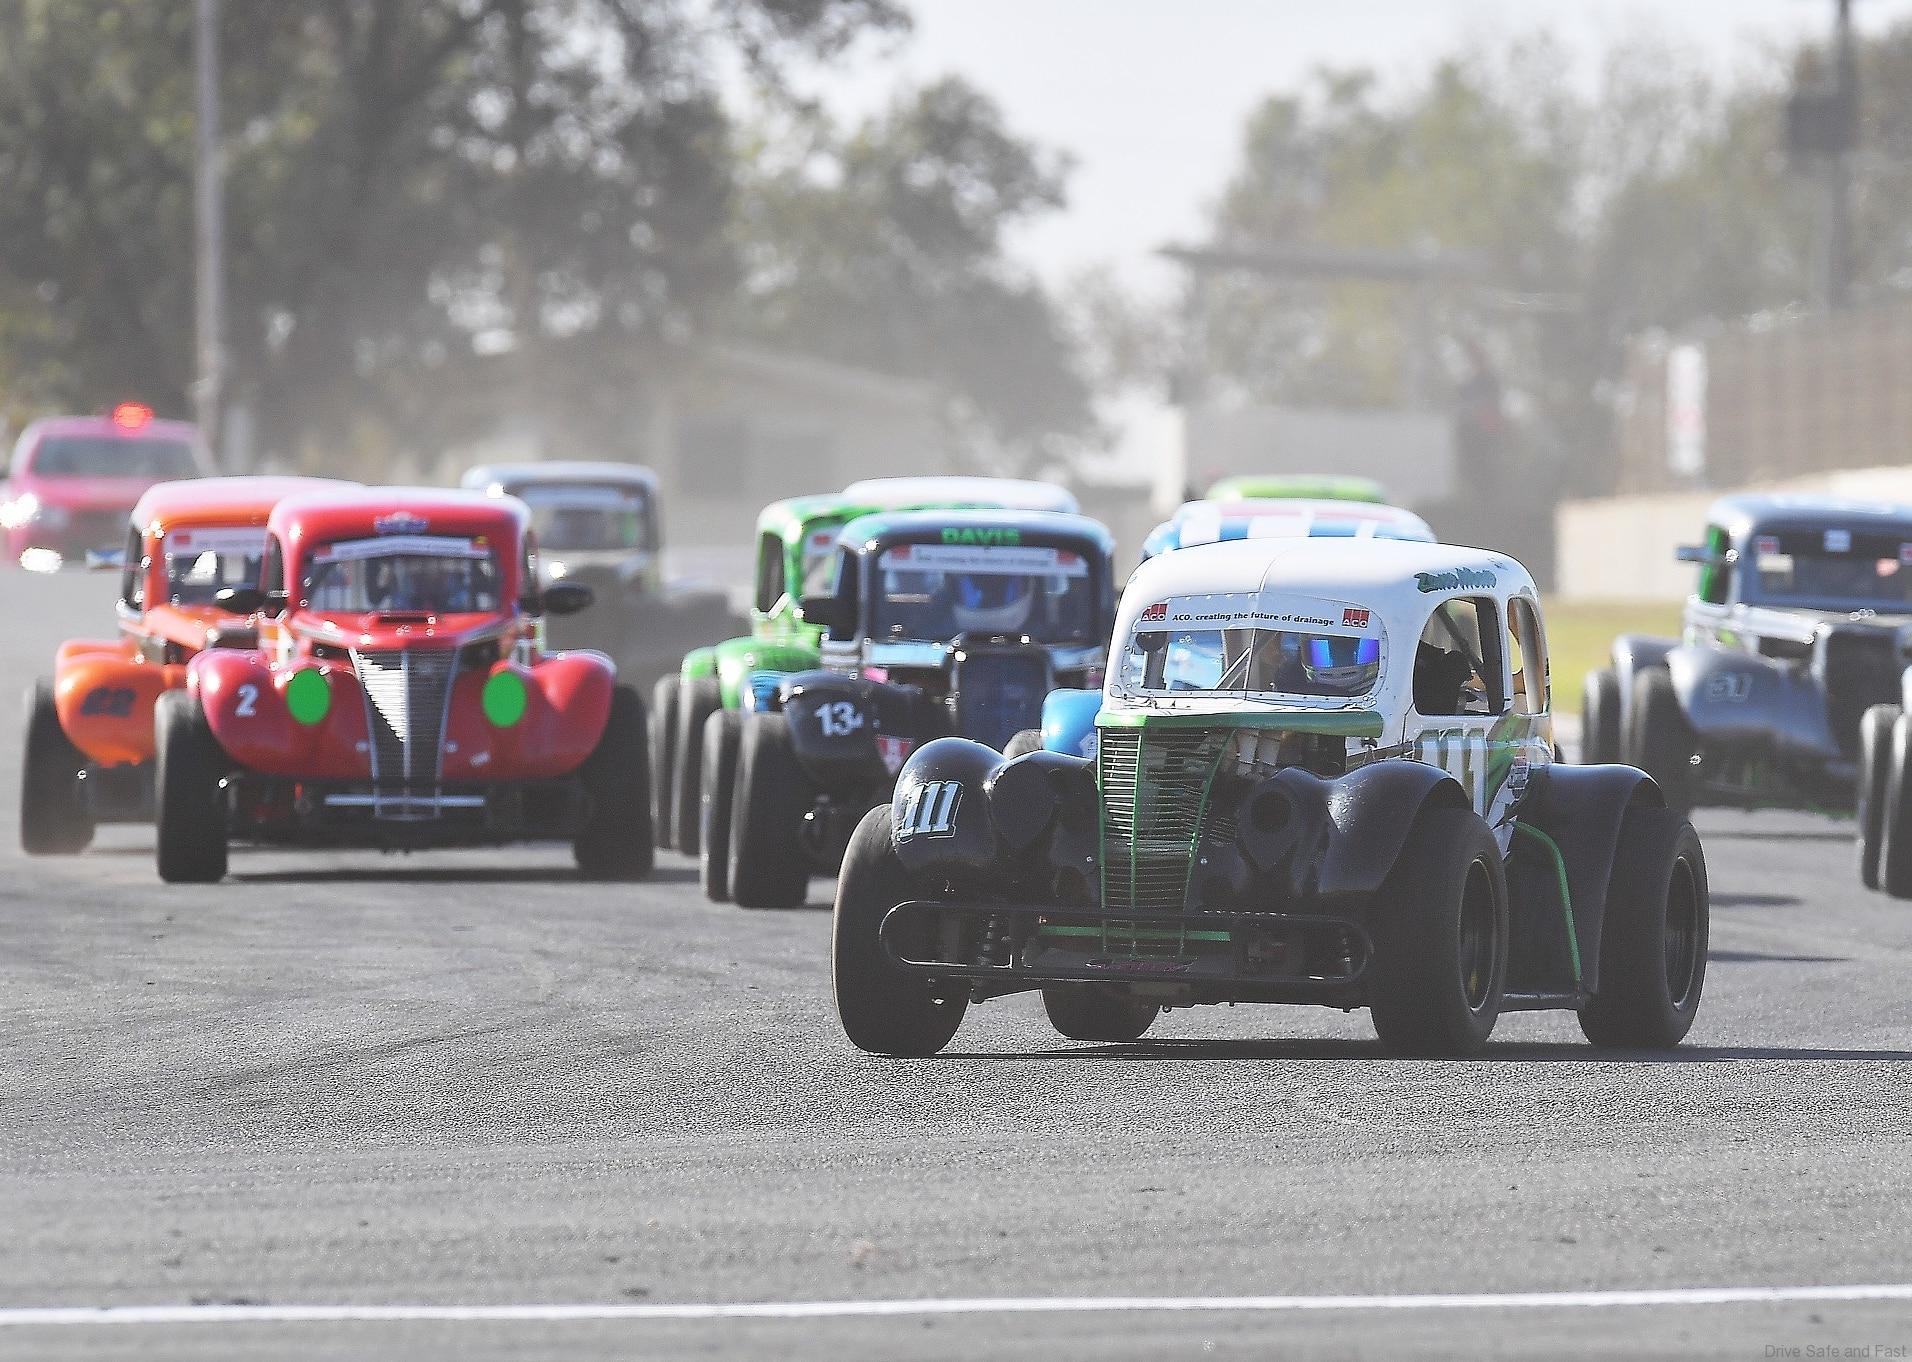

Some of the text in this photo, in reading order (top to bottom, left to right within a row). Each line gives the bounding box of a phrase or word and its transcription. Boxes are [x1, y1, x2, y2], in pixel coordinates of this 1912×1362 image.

[941, 527, 1020, 544] DAVIS
[1171, 611, 1335, 627] ACO. creating the future of drainage
[235, 684, 258, 717] 2
[896, 781, 962, 842] 111
